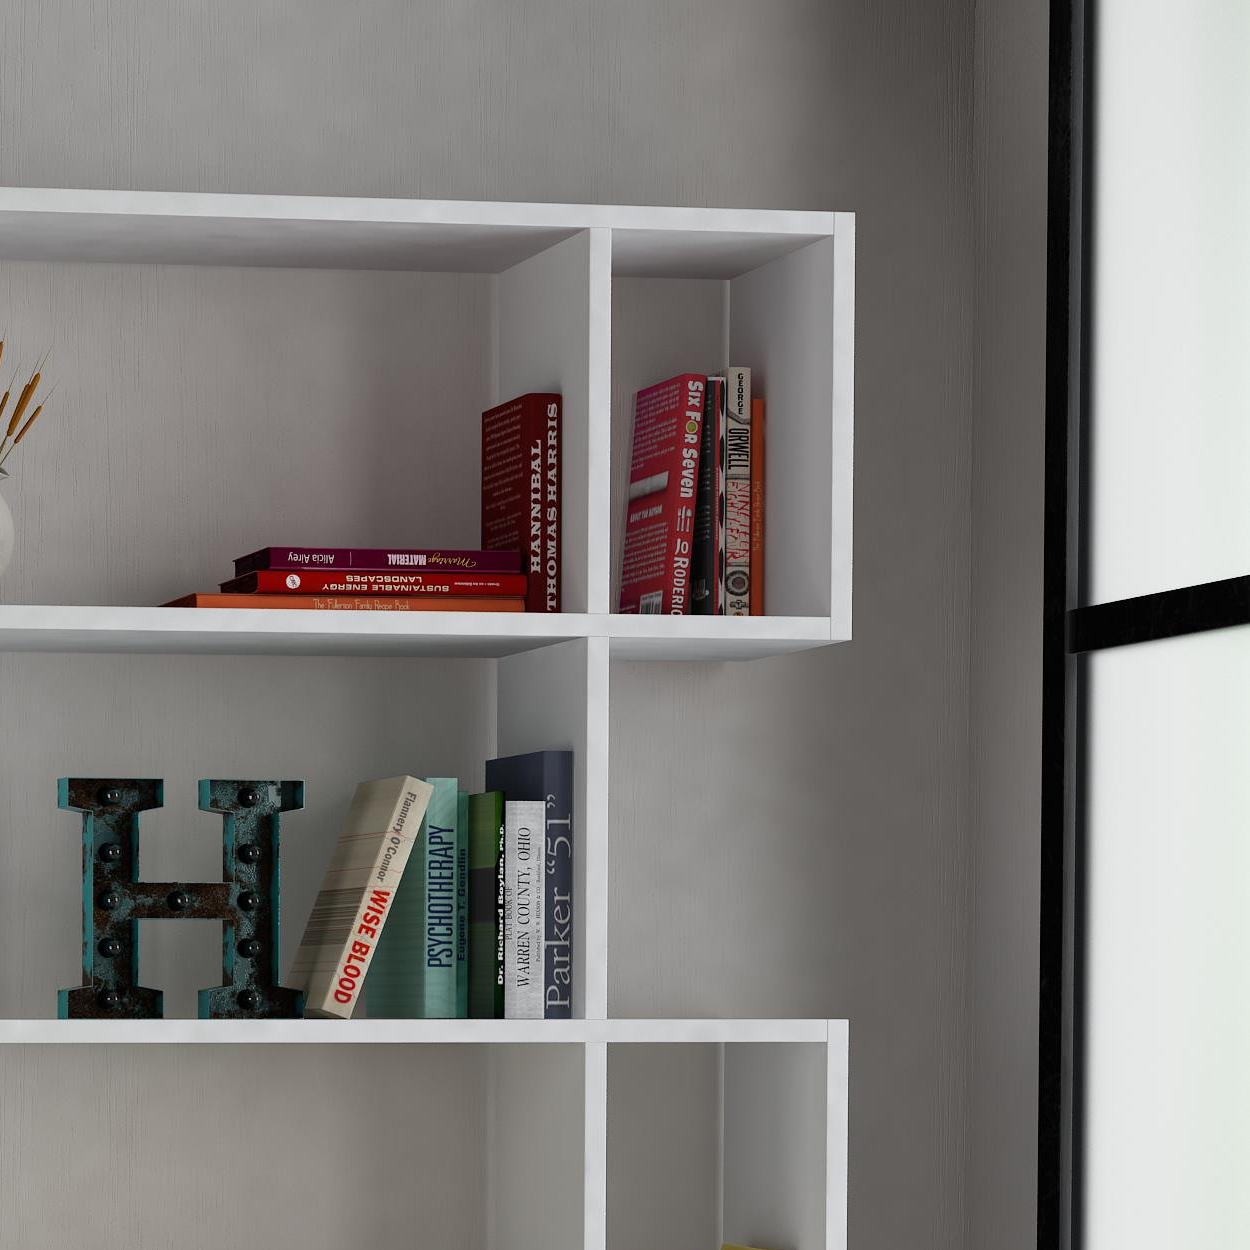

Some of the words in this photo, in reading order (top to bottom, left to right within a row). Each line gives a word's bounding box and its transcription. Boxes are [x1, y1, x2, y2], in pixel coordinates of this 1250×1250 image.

[547, 403, 558, 502] HARRIS
[728, 428, 749, 470] ORWELL
[531, 440, 541, 573] HANNIBAL
[288, 552, 310, 565] Airey
[312, 554, 335, 565] Alicia
[346, 575, 422, 583] LANDSCAPES
[387, 554, 427, 566] MATERIAL
[547, 507, 557, 611] THOMAS
[323, 583, 367, 592] ENERGY
[372, 584, 450, 592] SUSTAINABLE
[393, 791, 417, 836] Flannery
[376, 837, 401, 882] O'Connor
[517, 828, 530, 861] OHIO
[358, 890, 390, 938] WISE
[428, 825, 454, 968] PSYCHOTHERAPY
[517, 867, 532, 925] COUNTY,
[517, 931, 530, 987] WARREN
[545, 887, 570, 1008] Parker
[334, 941, 370, 1003] BLOOD
